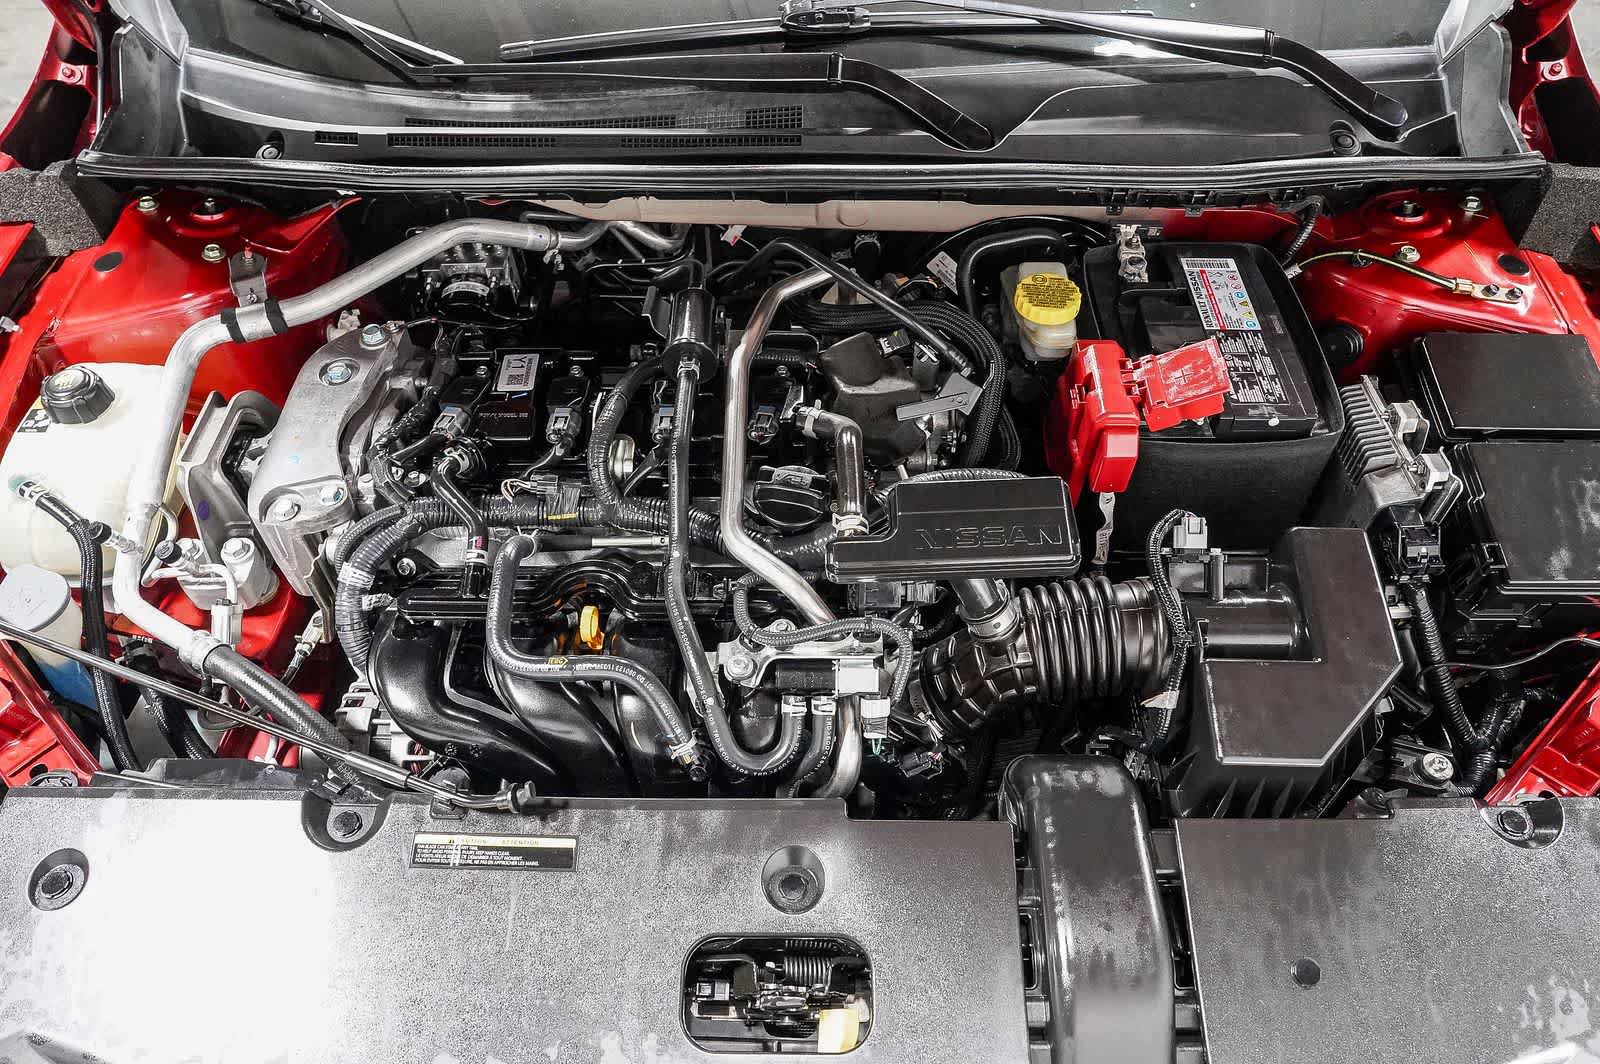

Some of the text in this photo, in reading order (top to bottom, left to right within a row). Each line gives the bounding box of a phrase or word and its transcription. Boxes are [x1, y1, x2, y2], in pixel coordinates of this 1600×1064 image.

[1187, 270, 1203, 299] NISSAN
[1198, 301, 1215, 328] RENAULT
[911, 524, 1063, 550] NISSAN
